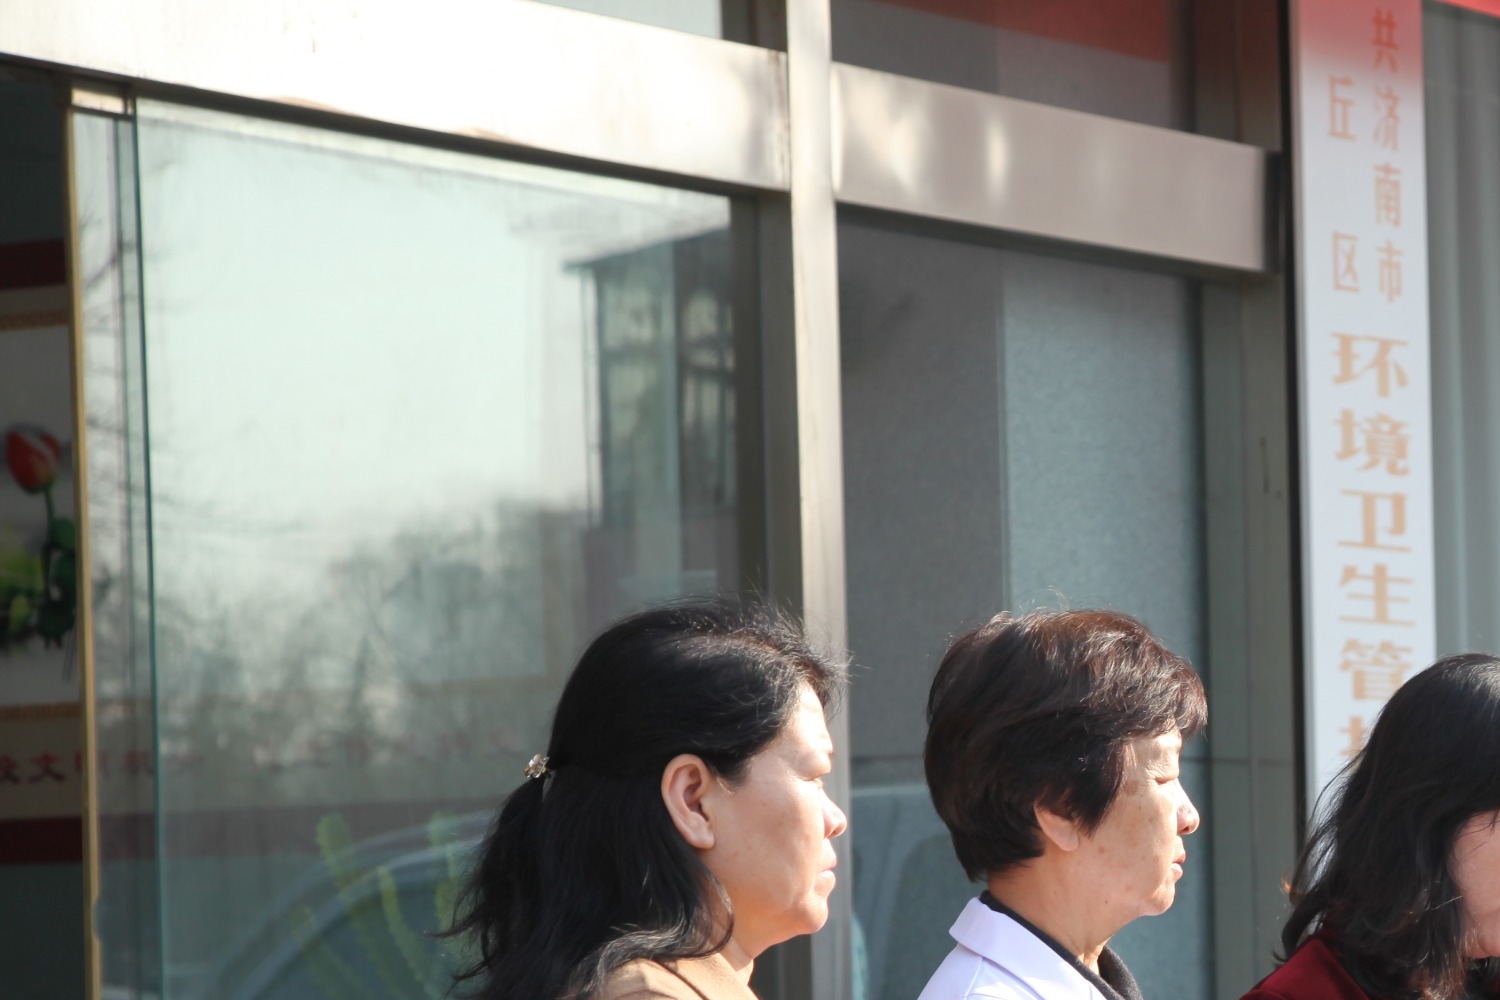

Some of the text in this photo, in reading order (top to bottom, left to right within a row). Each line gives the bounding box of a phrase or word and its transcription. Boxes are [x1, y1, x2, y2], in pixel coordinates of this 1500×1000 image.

[1330, 332, 1415, 765] 环境卫生管
